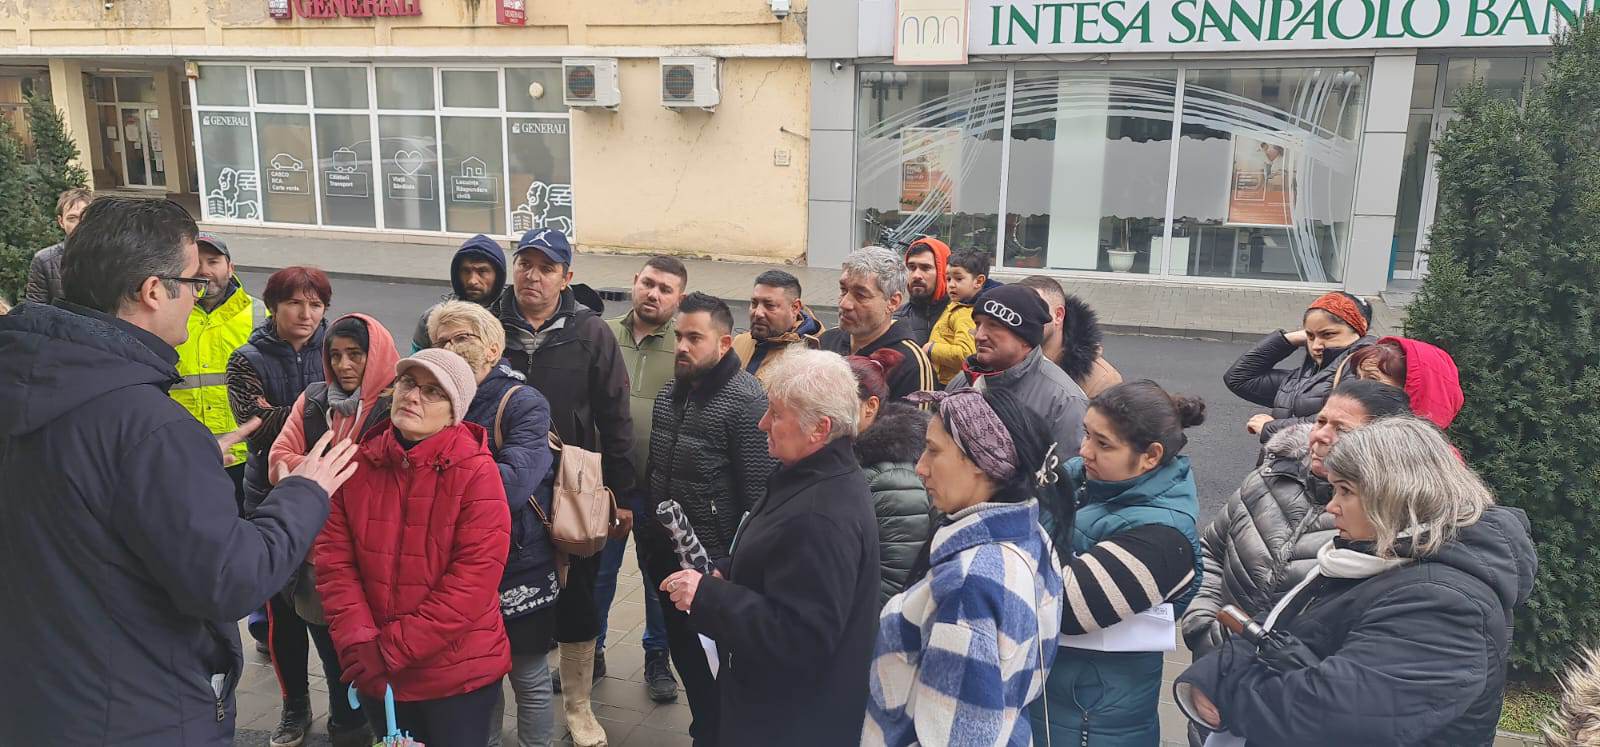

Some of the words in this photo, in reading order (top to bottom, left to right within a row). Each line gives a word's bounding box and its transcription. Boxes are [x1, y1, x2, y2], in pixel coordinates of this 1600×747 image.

[988, 1, 1155, 46] INTESA
[1168, 0, 1450, 43] SANPAOLO
[1460, 0, 1600, 36] BAN
[210, 115, 249, 126] GENERALI
[521, 122, 567, 134] GENERALI
[329, 180, 353, 188] Transport
